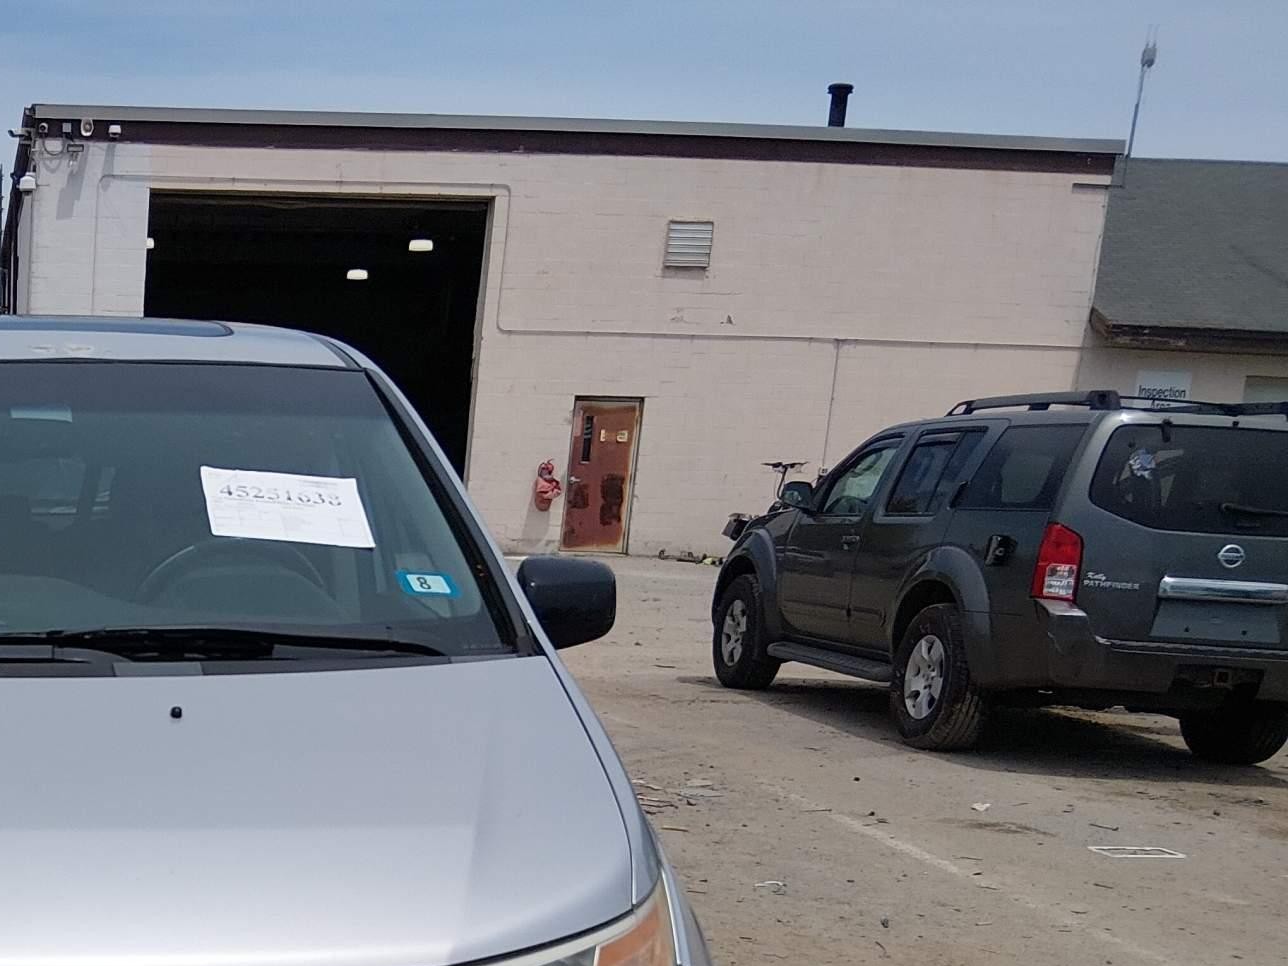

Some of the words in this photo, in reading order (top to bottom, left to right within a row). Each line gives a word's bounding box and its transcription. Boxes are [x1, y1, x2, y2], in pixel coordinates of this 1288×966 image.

[1138, 384, 1186, 399] Inspection
[416, 576, 432, 590] 8
[1083, 580, 1140, 589] PATHFINDER
